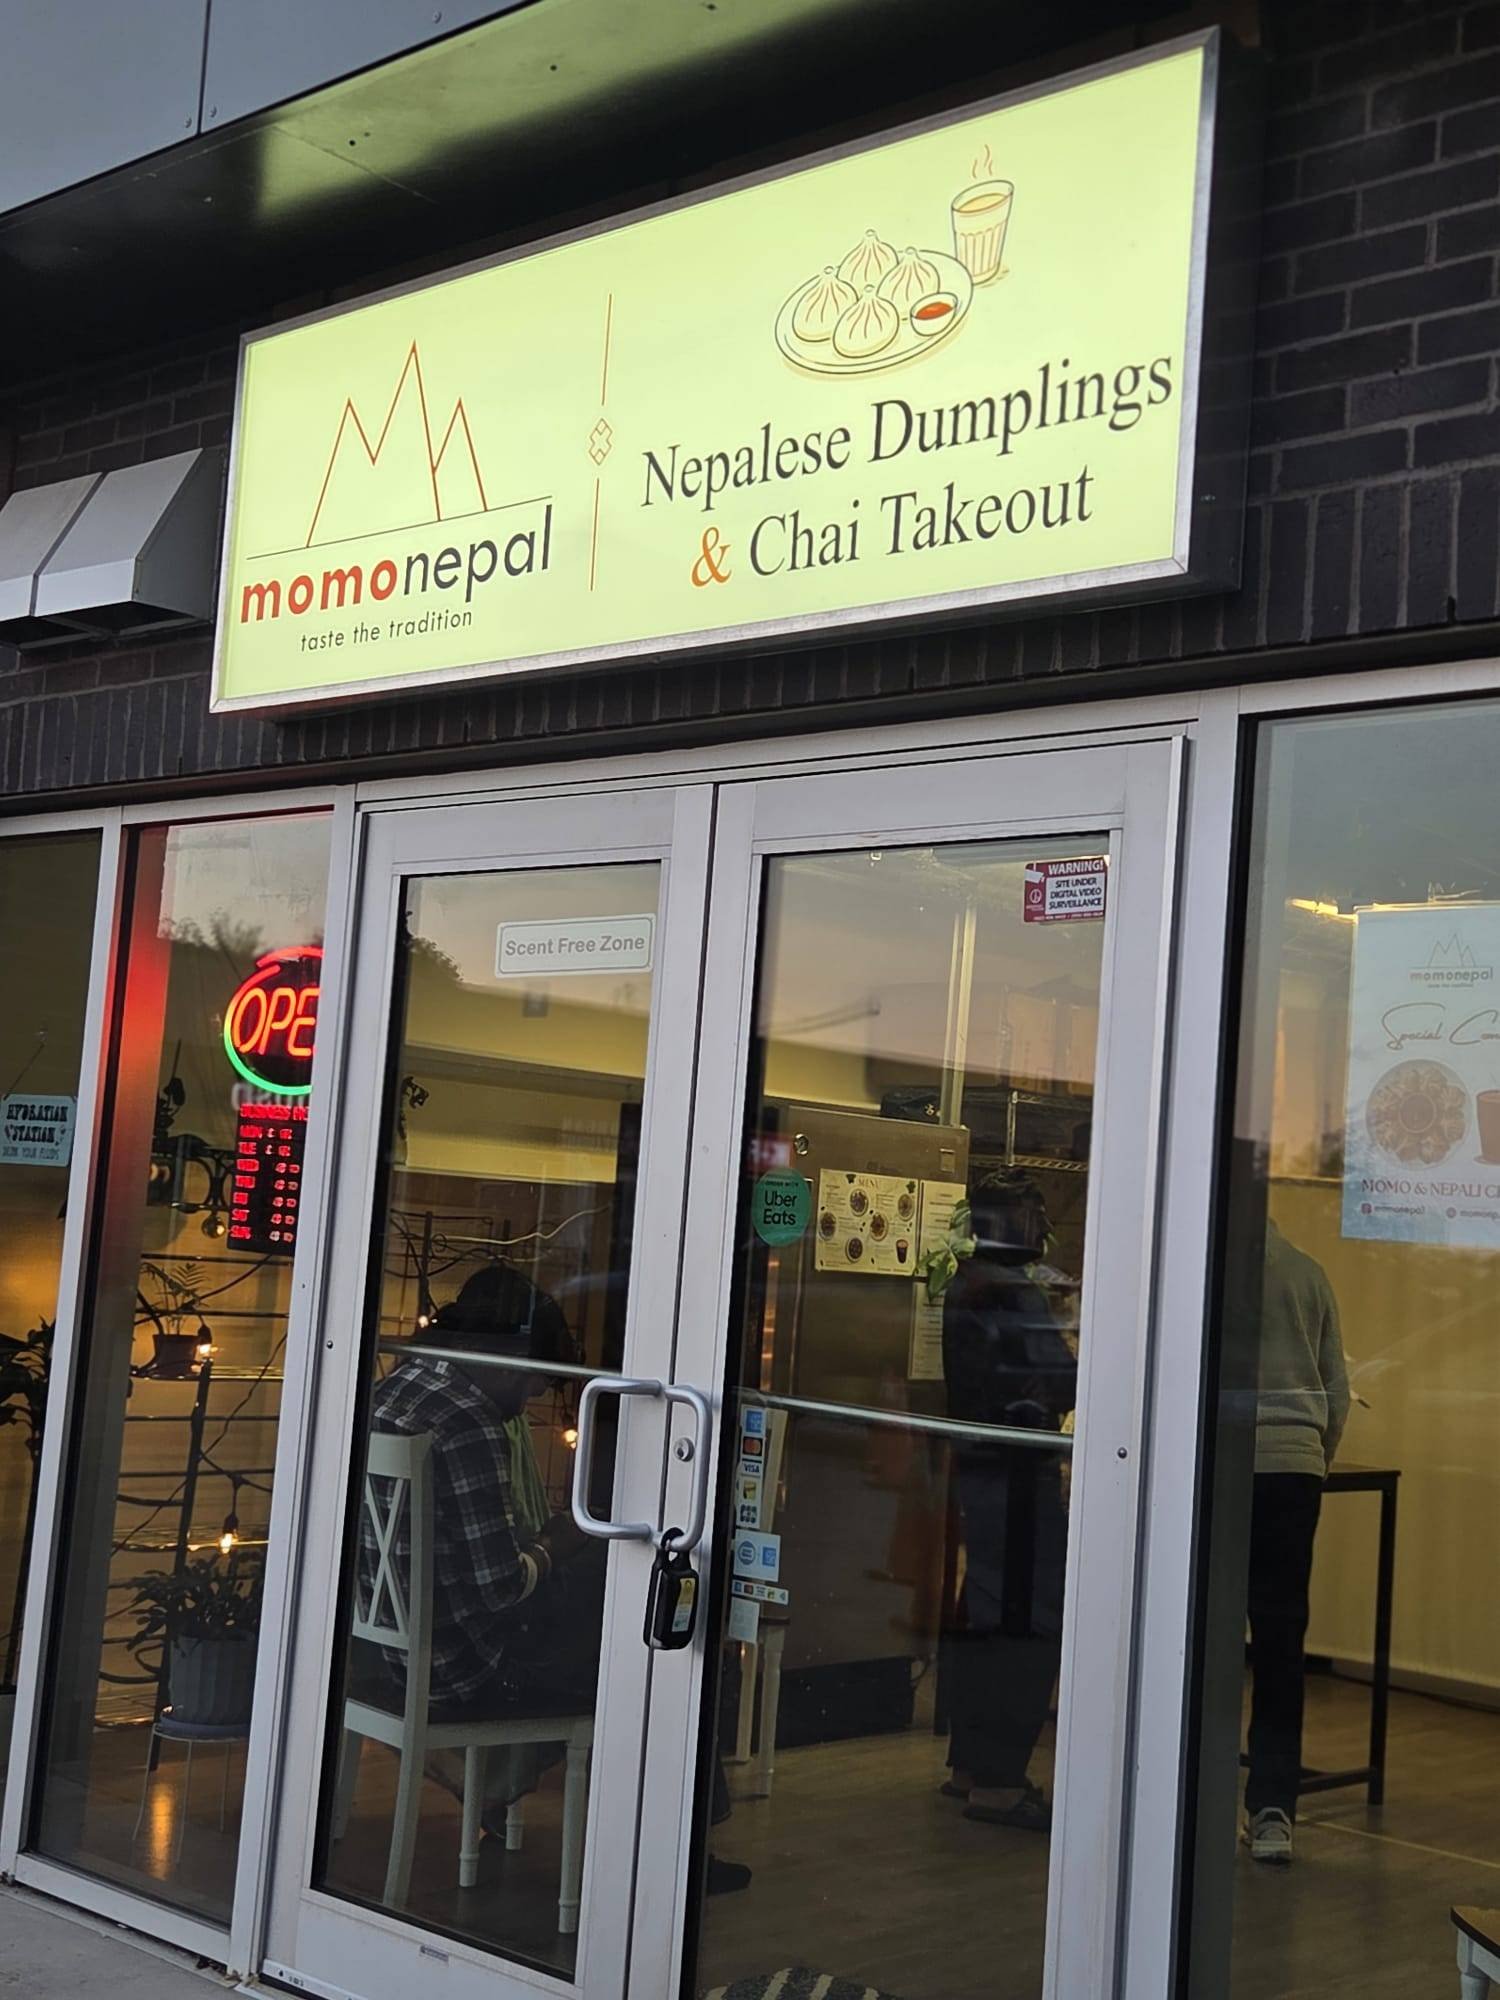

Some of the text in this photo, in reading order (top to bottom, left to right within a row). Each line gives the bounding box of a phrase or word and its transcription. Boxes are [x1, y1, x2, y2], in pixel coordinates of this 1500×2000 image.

[641, 356, 1173, 512] Nepalese Dumplings
[690, 464, 1095, 588] & Chai Takeout
[241, 504, 553, 624] momonepal
[301, 608, 472, 652] taste the tradition
[1048, 860, 1104, 875] WARNING!
[1055, 877, 1097, 888] SITE UNDER
[1050, 887, 1102, 899] DIGITAL VIDEO
[1049, 897, 1102, 910] SURVEILLANCE
[505, 936, 645, 956] Scent Free Zone
[1409, 966, 1494, 982] momonepal
[233, 987, 320, 1057] OPE
[1381, 1002, 1446, 1050] Special
[6, 1104, 69, 1122] HYDRATION
[10, 1124, 56, 1143] STATION
[1361, 1179, 1411, 1194] MOMO
[1414, 1182, 1427, 1195] &
[1430, 1182, 1481, 1198] NEPALI
[764, 1190, 797, 1207] Uber
[763, 1208, 797, 1226] Eats
[743, 1463, 760, 1473] VISA
